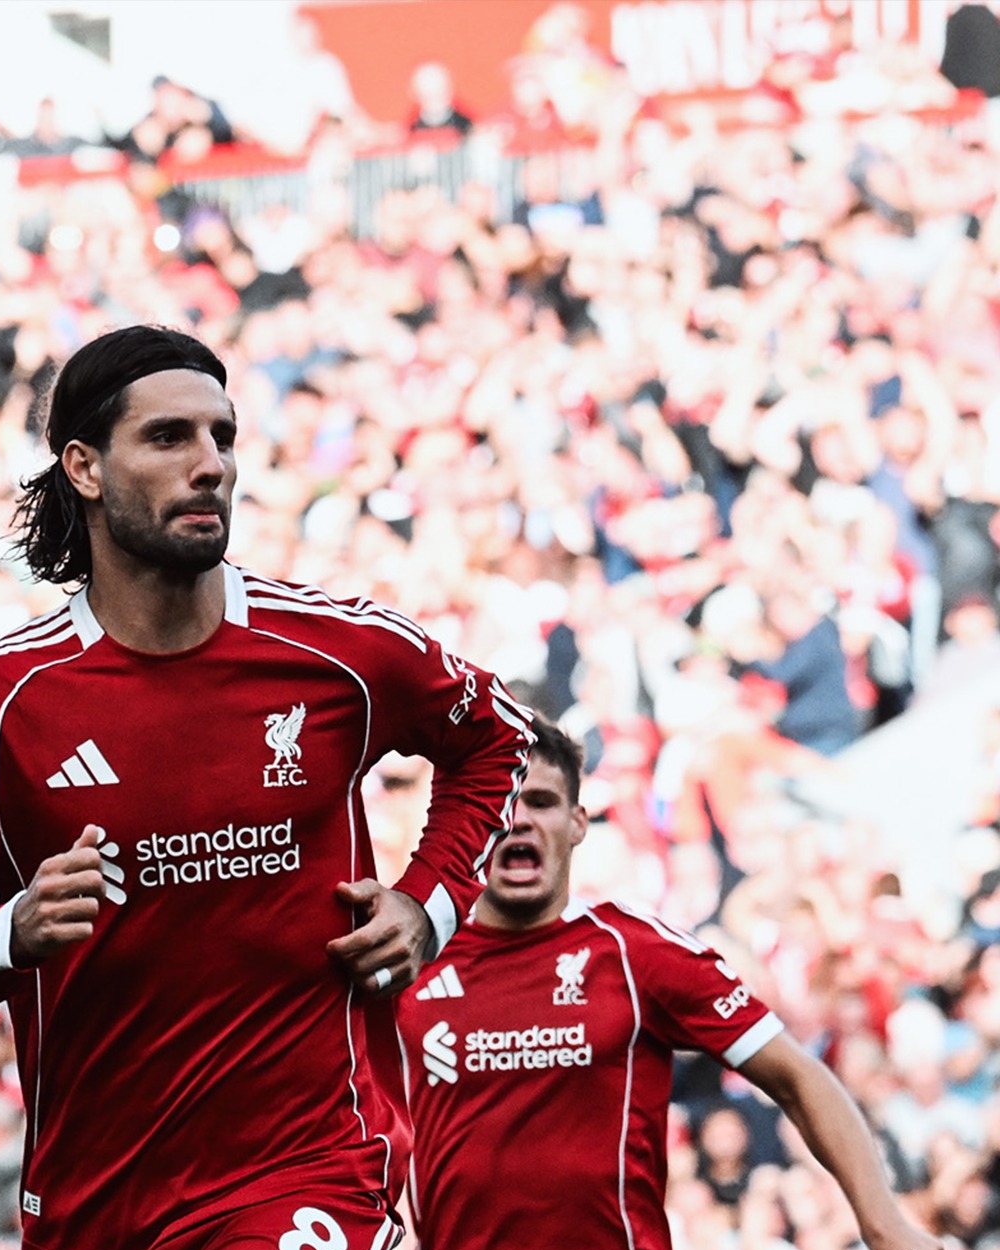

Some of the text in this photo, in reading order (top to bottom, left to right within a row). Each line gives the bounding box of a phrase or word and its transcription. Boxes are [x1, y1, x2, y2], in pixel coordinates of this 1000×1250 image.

[136, 817, 292, 861] standard
[139, 843, 300, 887] chartered
[464, 1022, 585, 1052] standard
[464, 1043, 593, 1072] chartered
